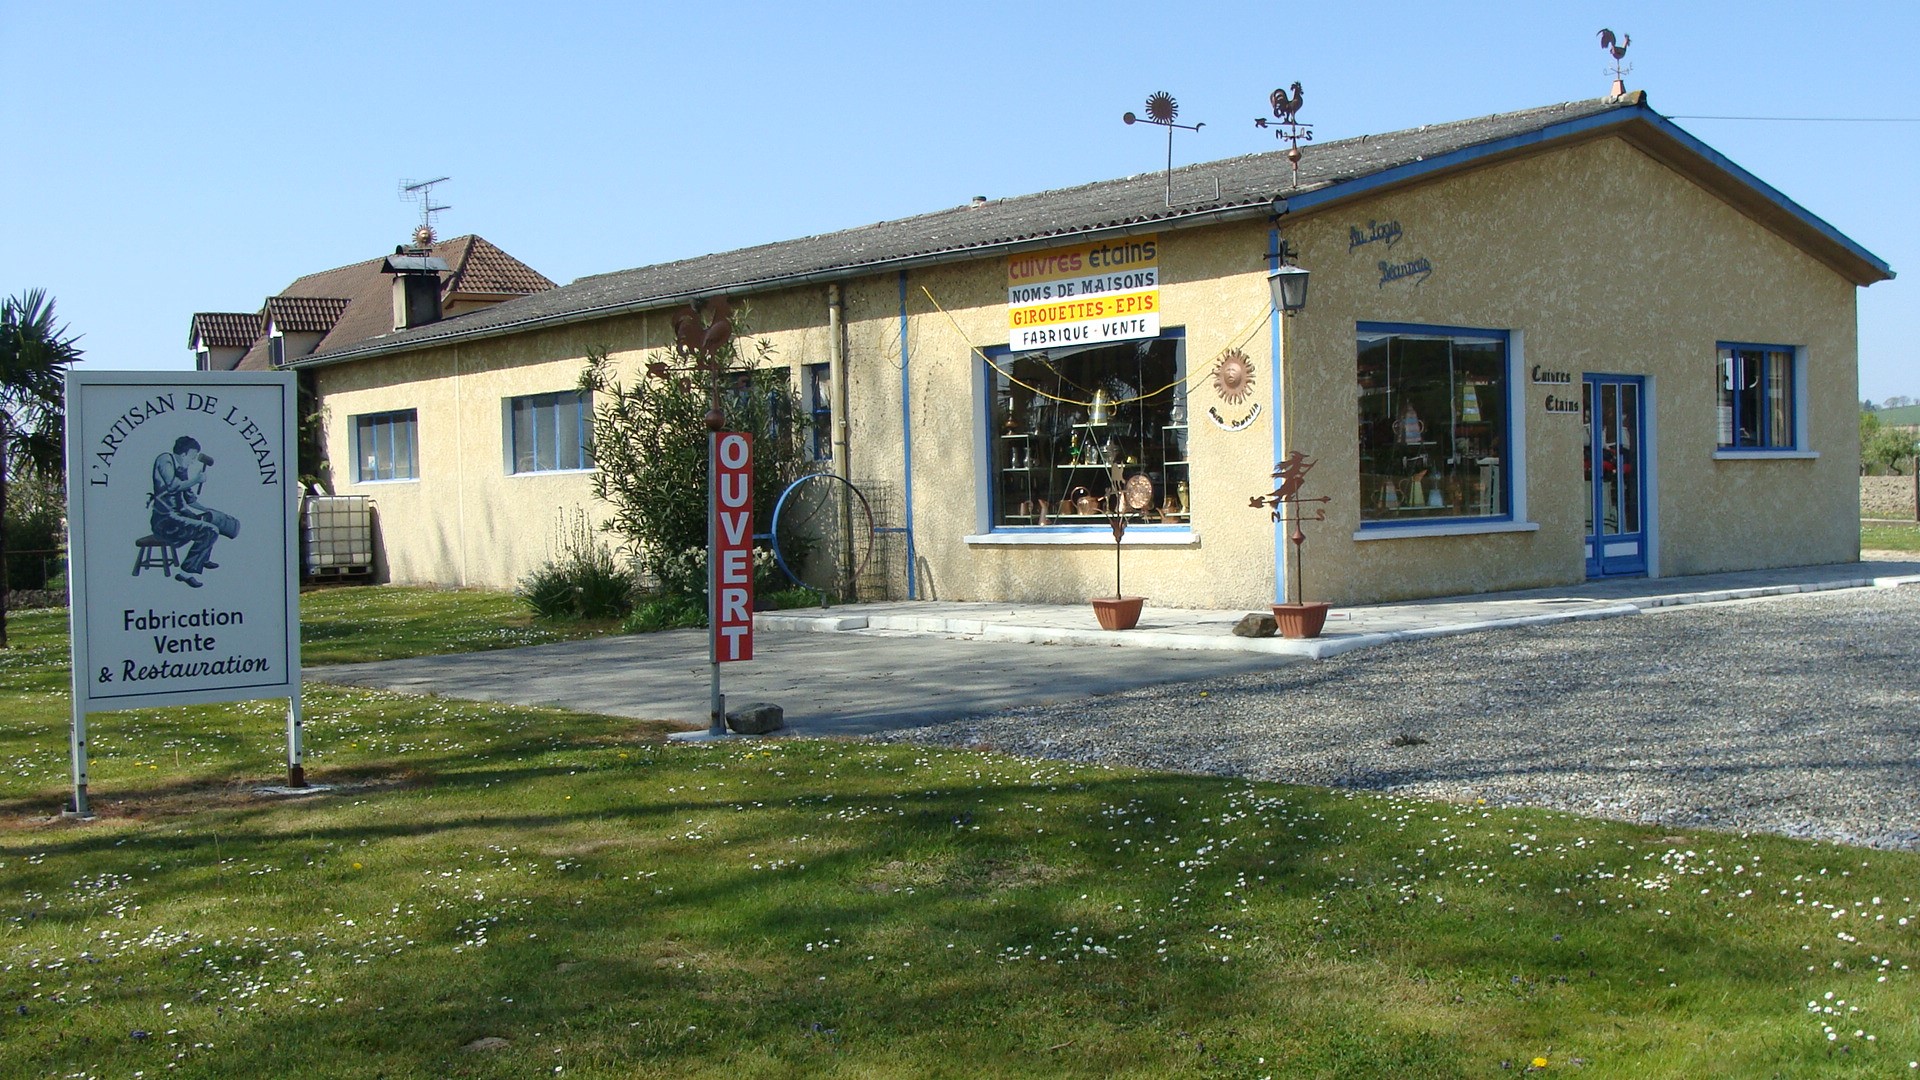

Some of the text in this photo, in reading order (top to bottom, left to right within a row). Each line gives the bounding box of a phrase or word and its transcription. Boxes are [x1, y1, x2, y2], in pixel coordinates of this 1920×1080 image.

[1009, 241, 1157, 279] cuivres etains
[1012, 272, 1154, 303] NOMS DE MAISONS
[1013, 301, 1104, 325] GIROUETTES
[1116, 295, 1154, 314] EPIS
[1023, 325, 1089, 345] FABRIQUE
[1102, 319, 1146, 337] VENTE
[1532, 365, 1571, 382] Cuivres
[1545, 394, 1579, 412] Etains
[90, 392, 279, 488] L'ARTISAN DE L'ETAIN
[719, 434, 750, 660] OUVERT
[124, 608, 244, 631] Fabrication
[153, 634, 216, 654] Vente
[98, 655, 270, 683] & Restauration
